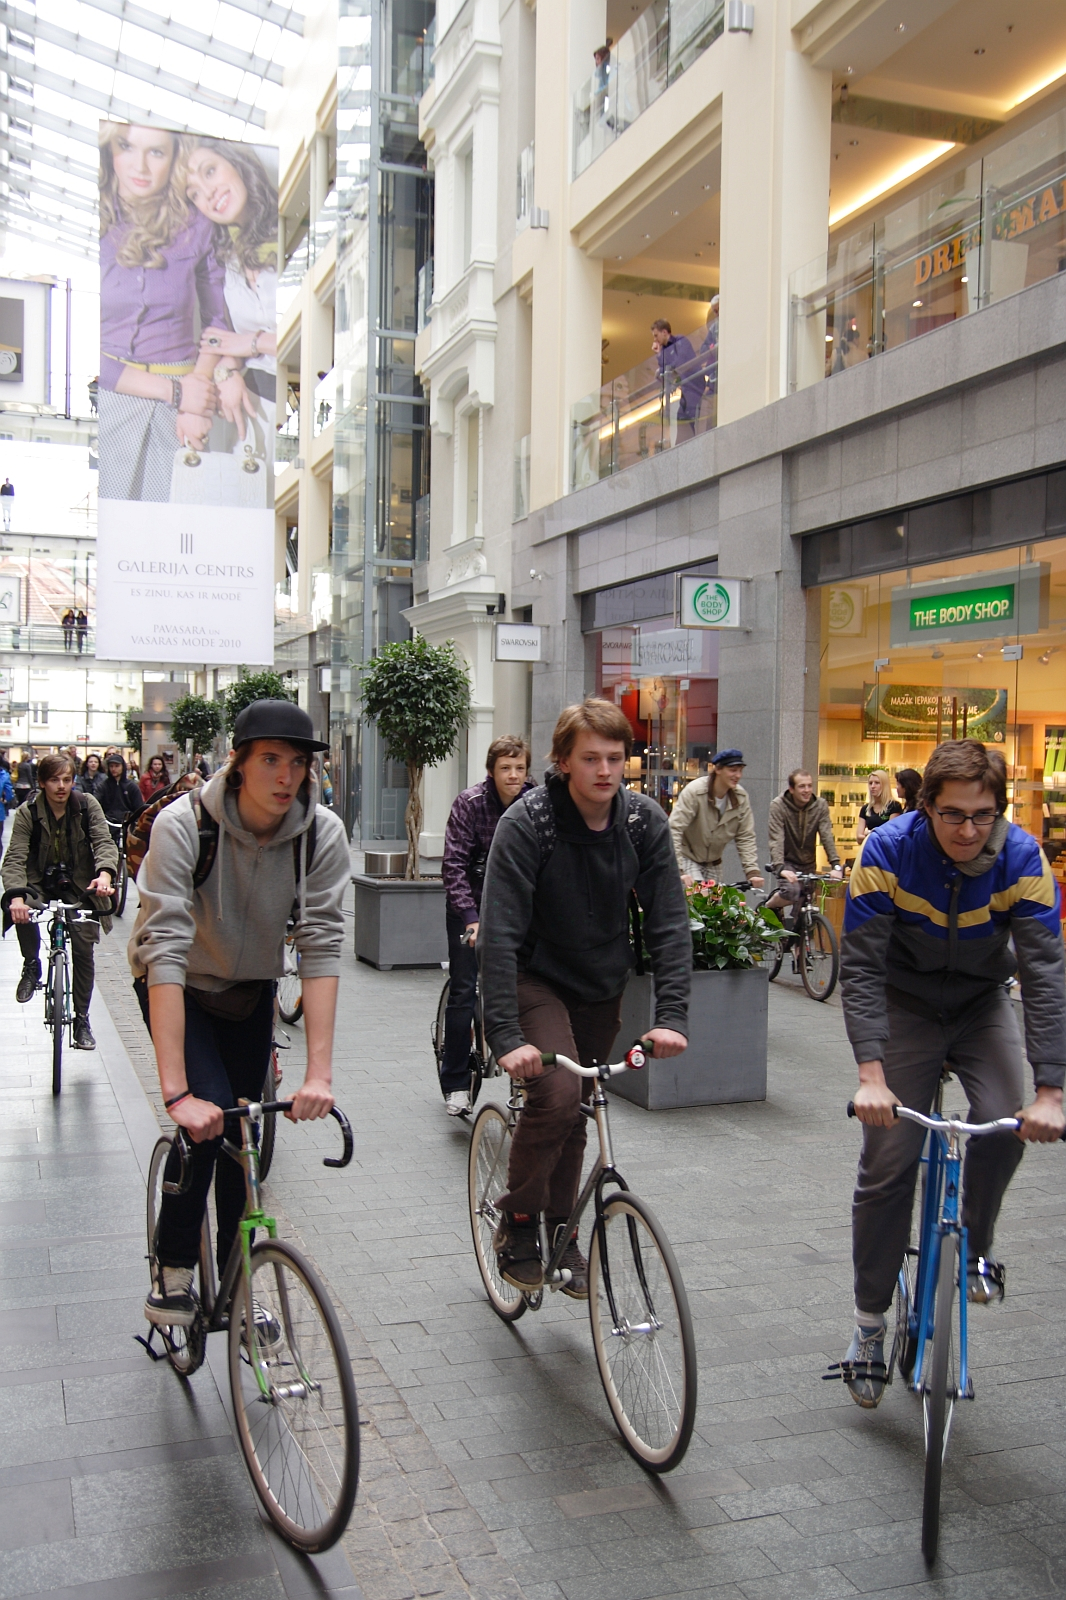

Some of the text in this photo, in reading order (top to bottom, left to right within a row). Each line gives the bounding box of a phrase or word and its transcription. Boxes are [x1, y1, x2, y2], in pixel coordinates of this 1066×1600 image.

[117, 560, 255, 578] GALERIJA CENTRS
[130, 588, 141, 597] ES
[176, 590, 194, 599] KAS
[198, 591, 209, 600] IR
[914, 599, 1010, 627] THE BODY SHOP
[153, 624, 206, 635] PAVASARA
[131, 635, 242, 648] VASARAS MODE 2010
[500, 638, 538, 646] SWAROVSKI
